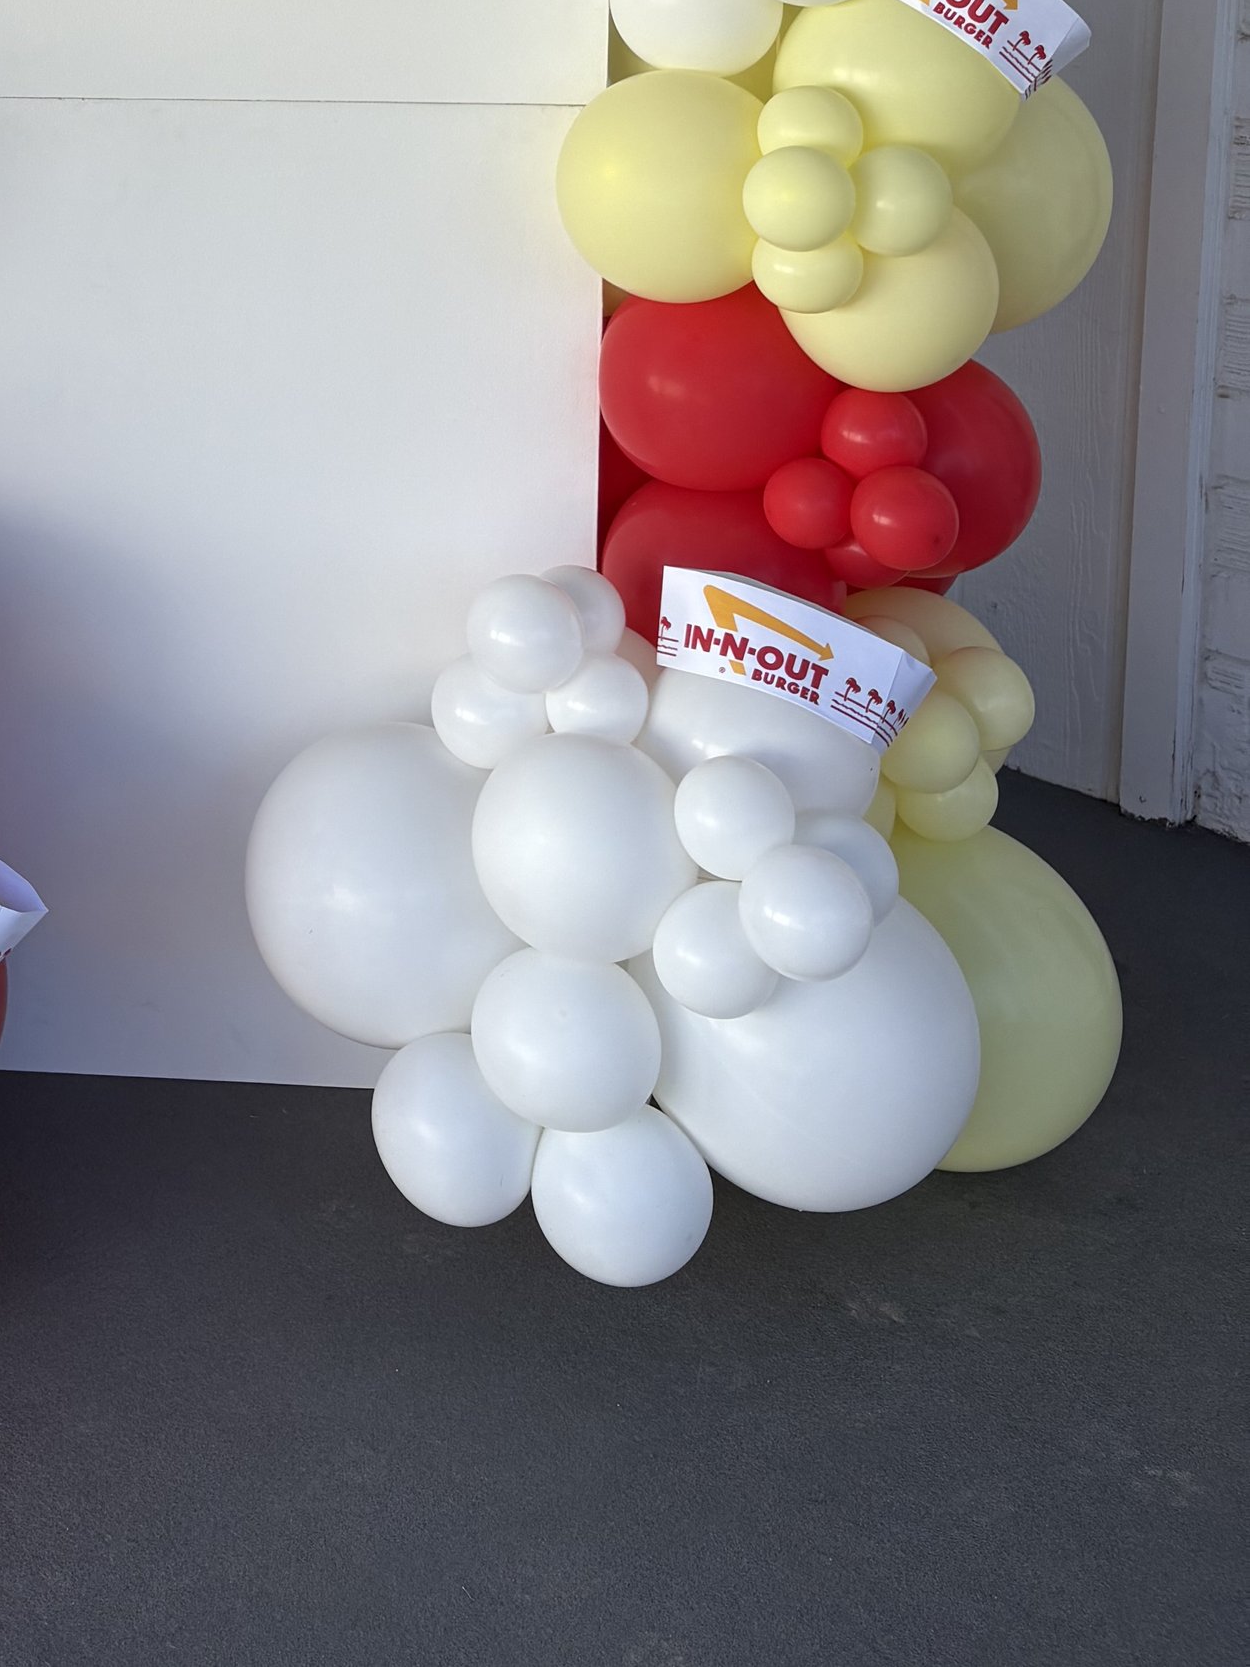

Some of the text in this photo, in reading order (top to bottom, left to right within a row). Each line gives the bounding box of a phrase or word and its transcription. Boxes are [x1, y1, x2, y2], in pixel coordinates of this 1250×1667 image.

[932, 1, 993, 50] BURGER
[683, 623, 829, 689] IN-N-OUT
[751, 669, 820, 706] BURGER
